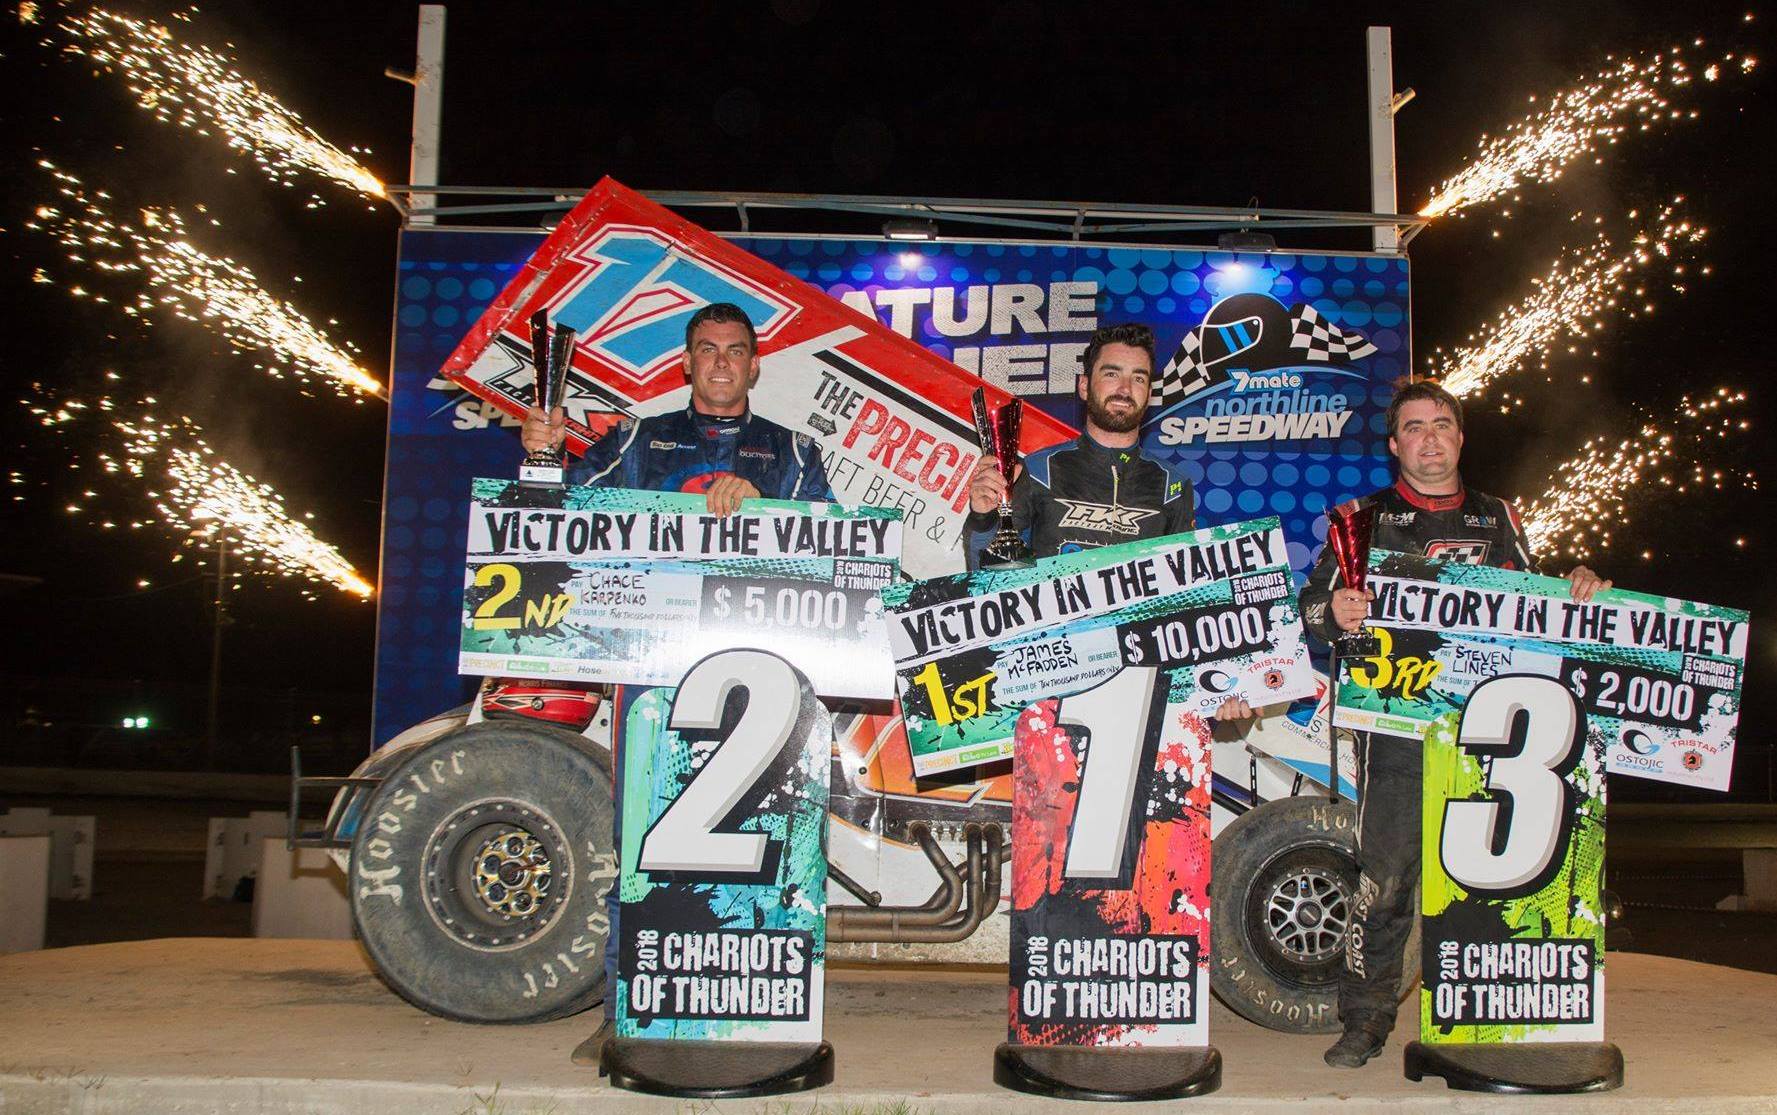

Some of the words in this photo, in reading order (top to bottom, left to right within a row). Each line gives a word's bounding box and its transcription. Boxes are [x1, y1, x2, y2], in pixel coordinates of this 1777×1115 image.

[813, 371, 864, 420] THE
[1231, 371, 1302, 393] 7mate
[1205, 389, 1347, 417] northline
[1159, 411, 1353, 445] SPEEDWAY
[485, 511, 637, 555] VICTORY
[649, 513, 684, 552] IN
[699, 515, 760, 556] THE
[773, 515, 890, 558] VALLEY
[590, 571, 645, 589] CHACE
[834, 575, 846, 589] OF
[848, 576, 892, 590] THUNDER
[845, 562, 892, 578] CHARIOTS
[1241, 572, 1286, 590] CHARIOTS
[473, 563, 576, 631] 2ND
[580, 591, 646, 606] KARPENKO
[744, 586, 848, 630] 5,000
[901, 583, 1043, 656] VICTORY
[1054, 574, 1092, 615] IN
[1097, 559, 1159, 606] THE
[1166, 529, 1273, 586] VALLEY
[1234, 593, 1246, 605] OF
[1247, 585, 1289, 603] THUNDER
[1124, 631, 1144, 664] $
[1152, 607, 1265, 662] 10,000
[1367, 581, 1505, 628] VICTORY
[1515, 596, 1548, 634] IN
[1562, 603, 1617, 643] THE
[1631, 610, 1737, 655] VALLEY
[1013, 641, 1072, 664] JAMES
[1247, 657, 1294, 673] TRISTAR
[1453, 660, 1499, 677] LINES
[1456, 645, 1512, 666] STEVEN
[1693, 659, 1736, 677] CHARIOTS
[914, 662, 997, 727] 1ST
[1003, 686, 1014, 695] THE
[1015, 684, 1028, 694] SUM
[1596, 671, 1695, 721] 2,000
[1682, 670, 1694, 683] OF
[1694, 672, 1735, 690] THUNDER
[637, 649, 804, 873] 2
[1616, 754, 1664, 769] OSTOJIC
[1671, 740, 1718, 754] TRISTAR
[1057, 664, 1160, 881] 1
[1440, 673, 1580, 893] 3
[636, 929, 659, 971] 2018
[664, 932, 804, 975] CHARIOTS
[1027, 936, 1049, 977] 2018
[1054, 938, 1191, 979] CHARIOTS
[1440, 940, 1459, 980] 2018
[1463, 942, 1588, 984] CHARIOTS
[632, 974, 666, 1014] OF
[673, 975, 804, 1016] THUNDER
[1023, 979, 1057, 1018] OF
[1063, 980, 1191, 1019] THUNDER
[1436, 982, 1467, 1019] OF
[1472, 982, 1590, 1020] THUNDER
